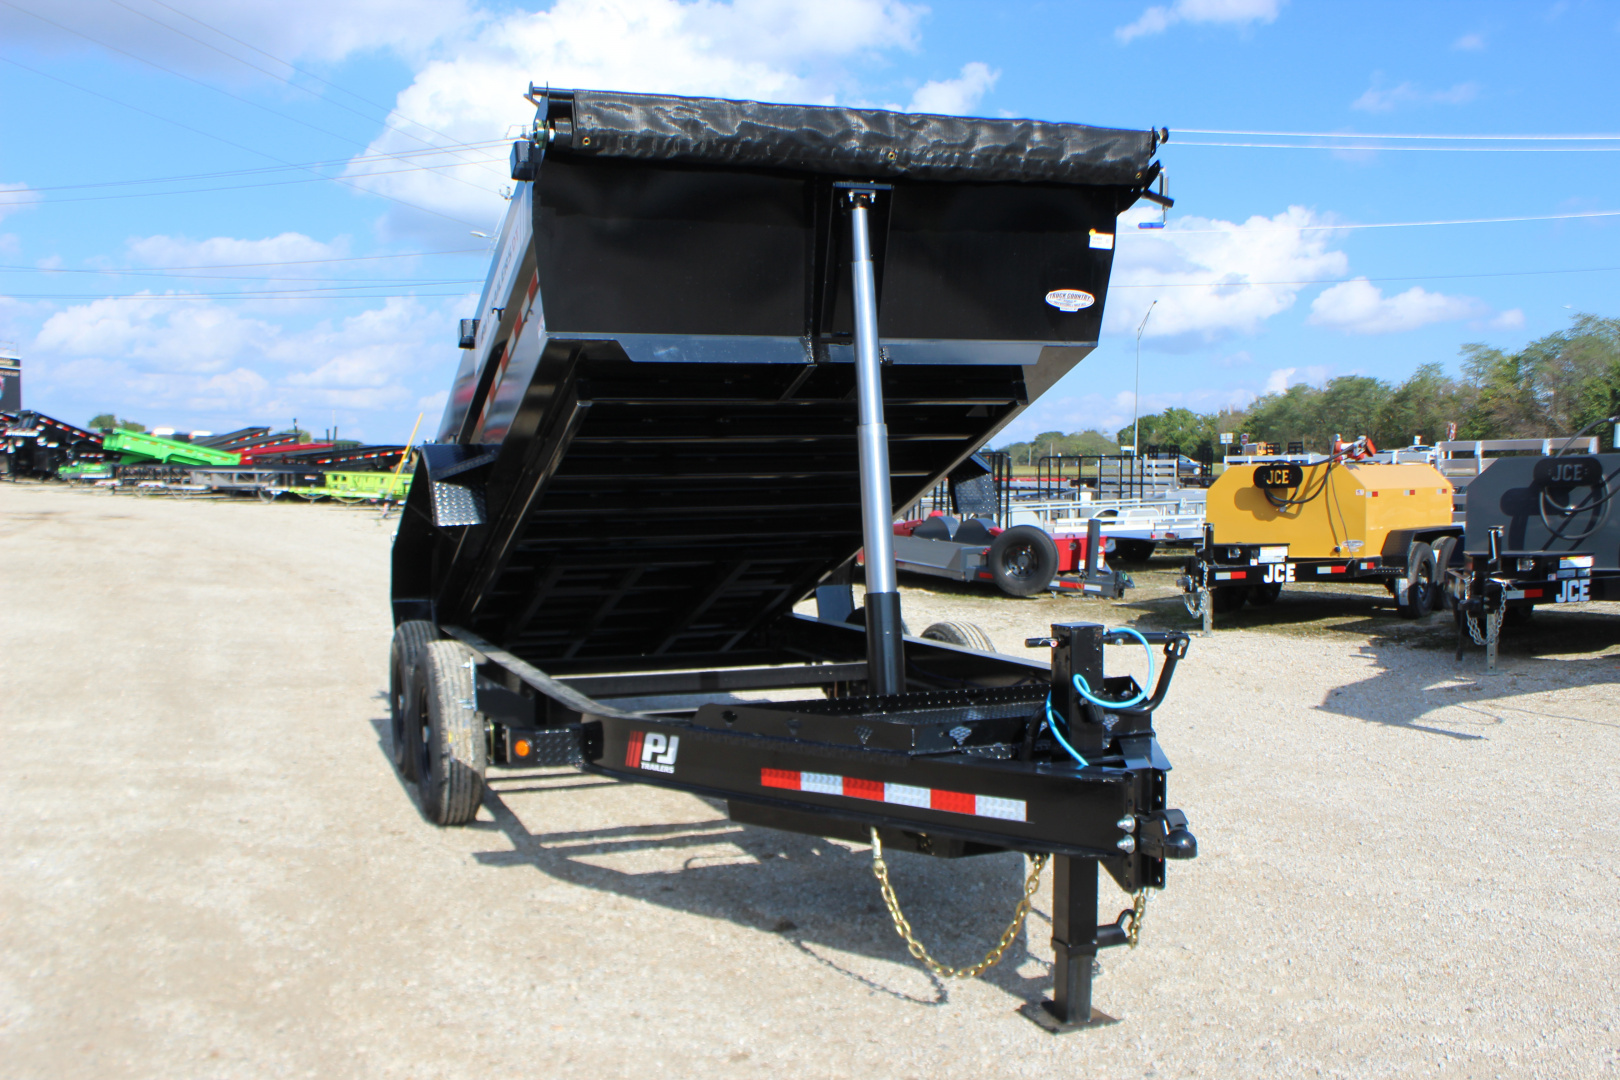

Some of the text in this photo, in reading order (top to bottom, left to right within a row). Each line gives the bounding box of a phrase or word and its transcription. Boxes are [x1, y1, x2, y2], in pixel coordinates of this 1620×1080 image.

[1049, 292, 1066, 300] TRUCK
[1066, 292, 1091, 301] COUNTRY
[1266, 469, 1290, 485] JCE
[1552, 464, 1583, 482] JCE
[1263, 563, 1297, 584] JCE
[1555, 579, 1592, 603] JCE
[641, 731, 680, 765] PJ
[641, 762, 675, 774] TRAILERS
